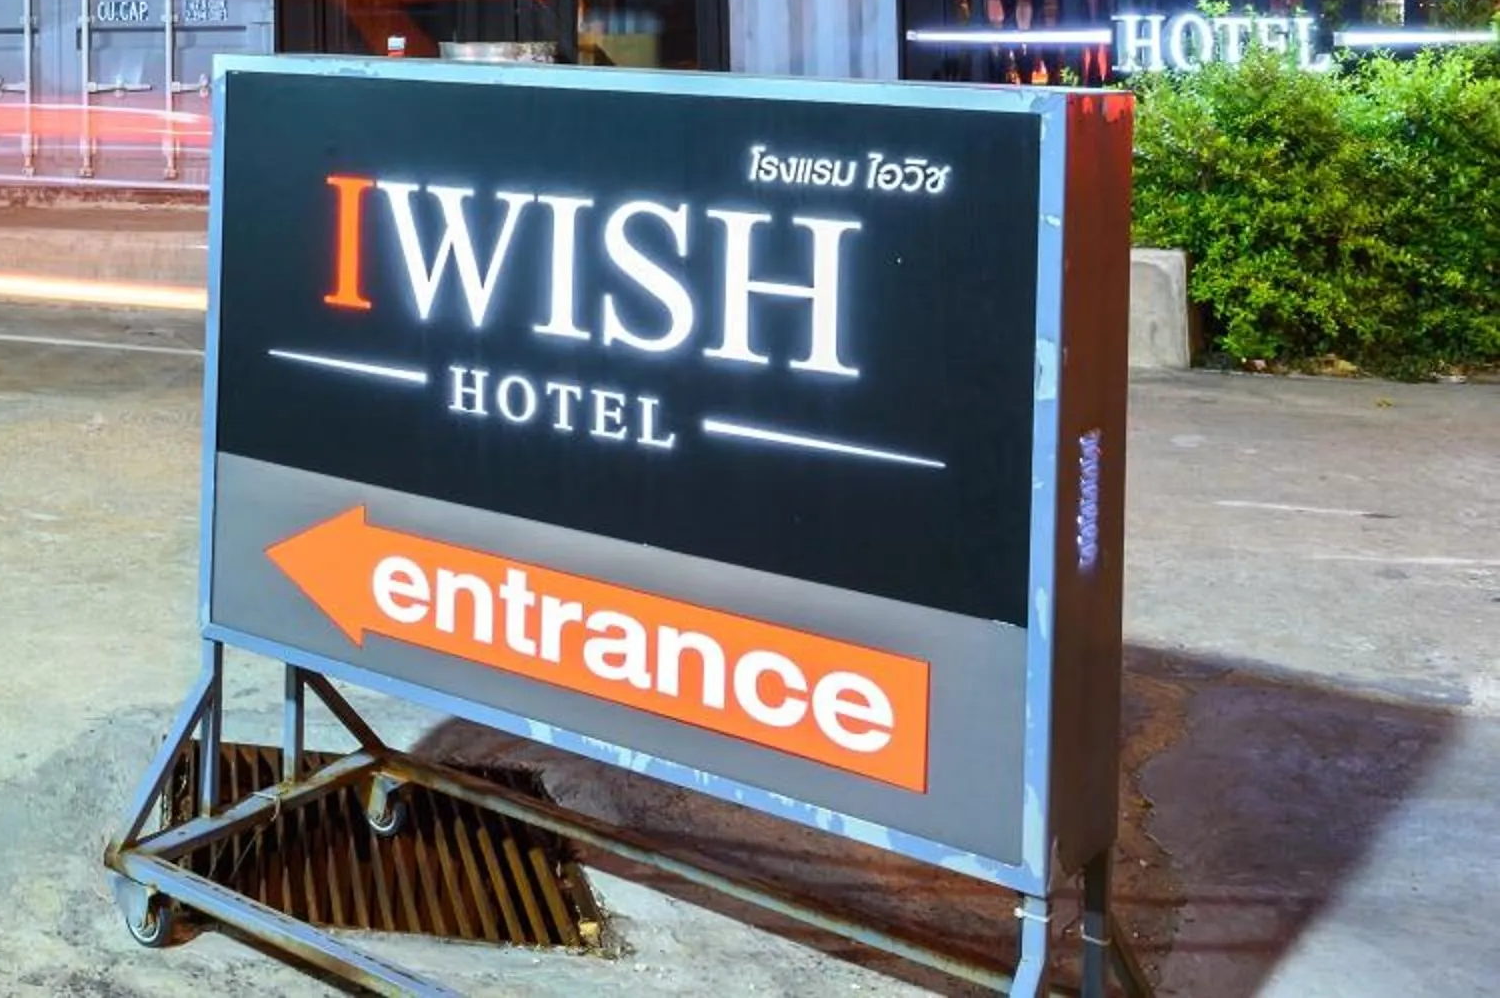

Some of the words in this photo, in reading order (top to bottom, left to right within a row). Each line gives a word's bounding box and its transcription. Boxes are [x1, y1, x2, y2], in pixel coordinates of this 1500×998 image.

[1111, 12, 1334, 73] HOTEL
[749, 145, 858, 187] โรงแรม
[866, 152, 952, 193] ไอวิช
[448, 366, 677, 450] HOTEL
[371, 555, 898, 754] entrance
